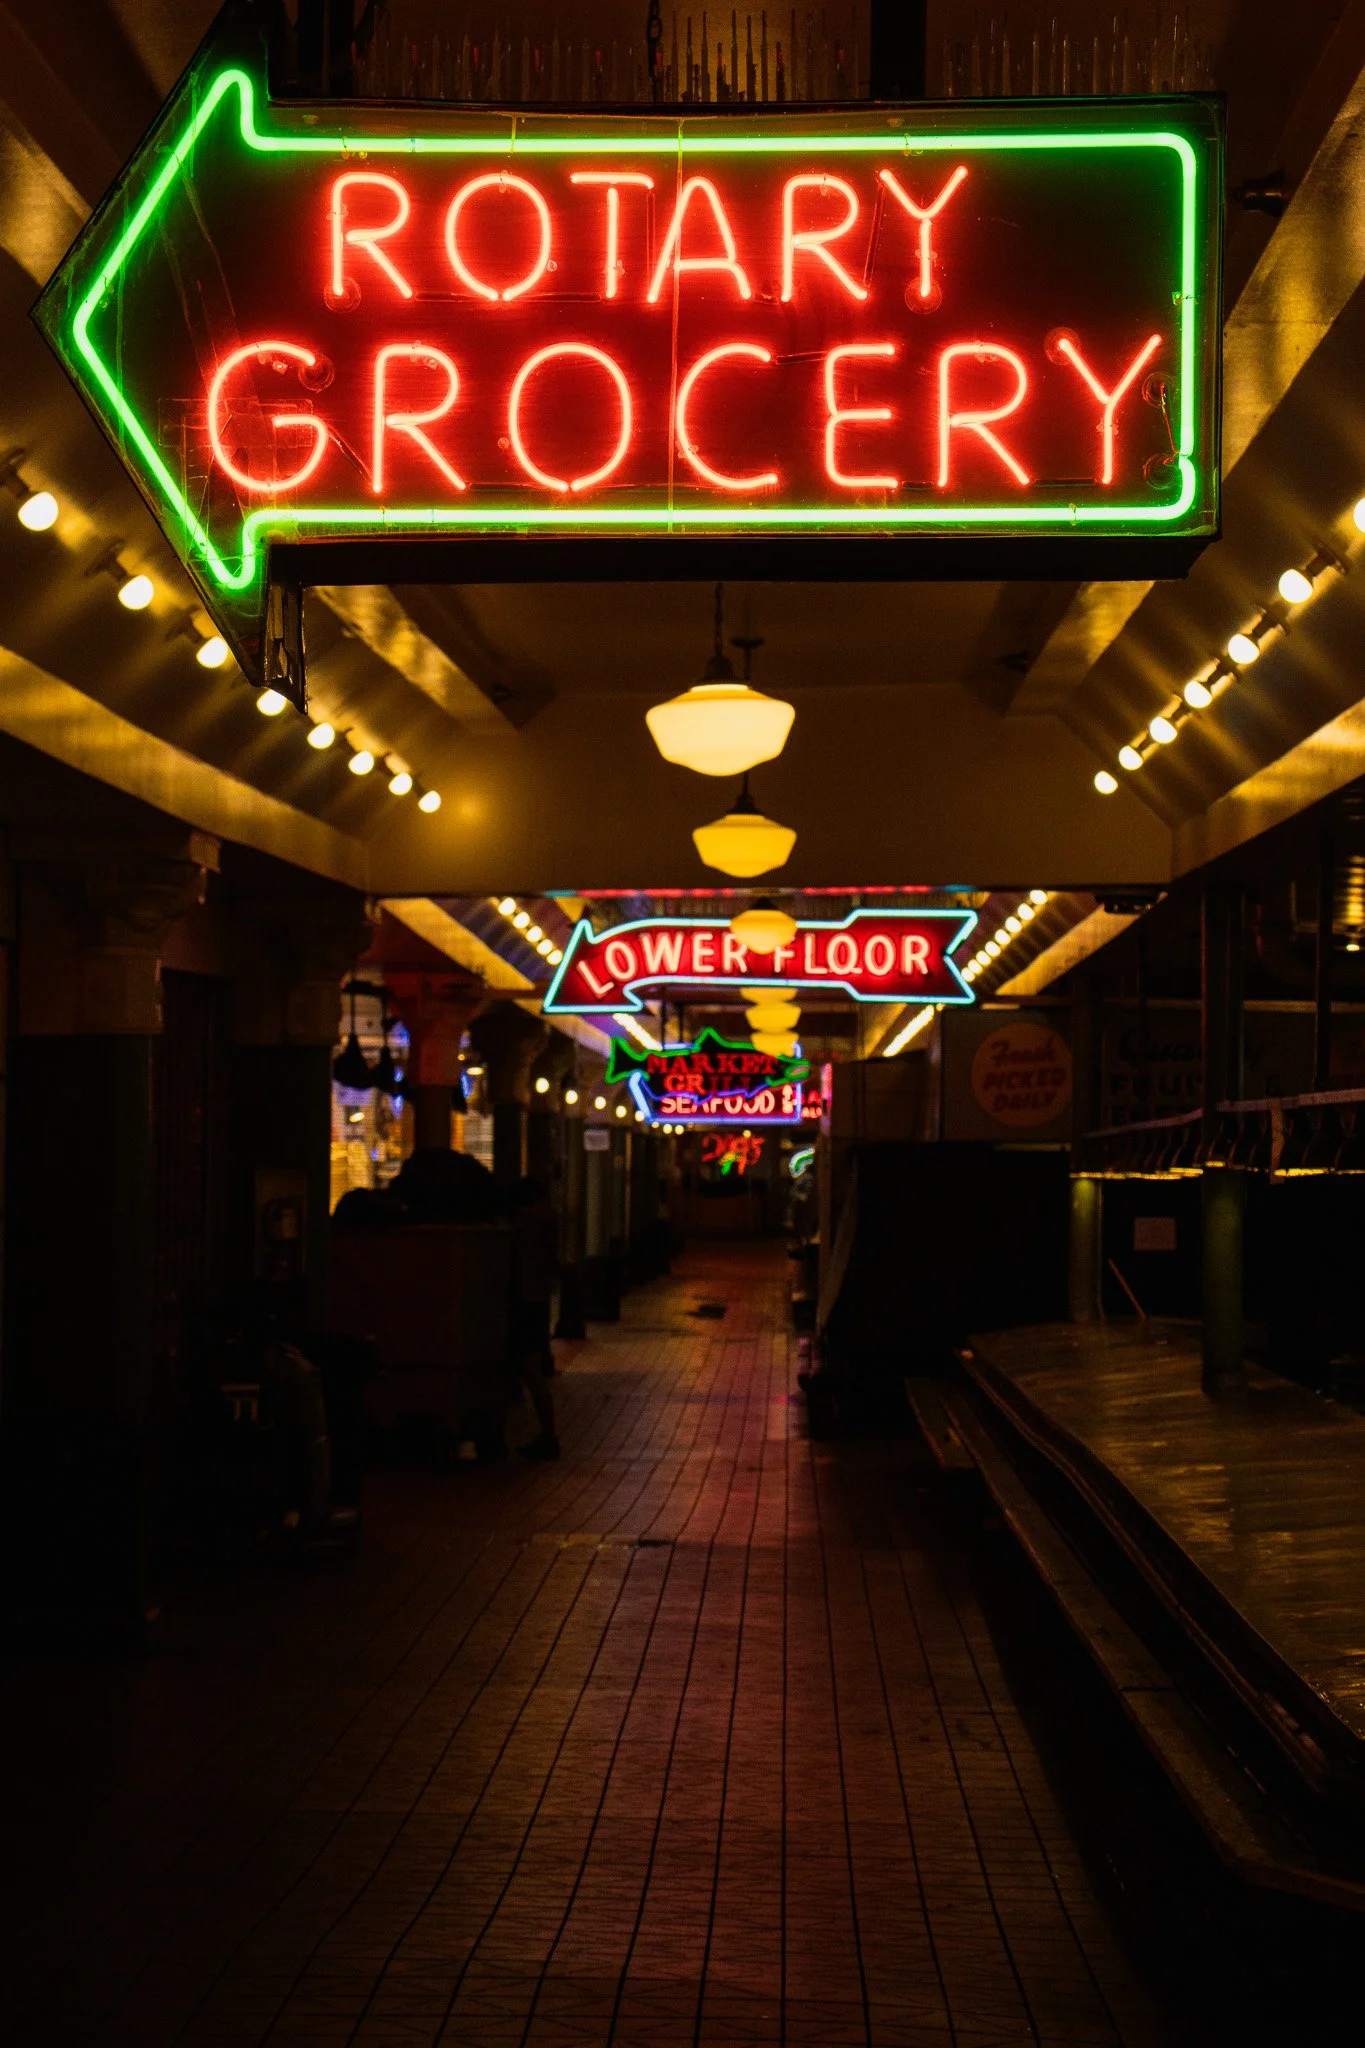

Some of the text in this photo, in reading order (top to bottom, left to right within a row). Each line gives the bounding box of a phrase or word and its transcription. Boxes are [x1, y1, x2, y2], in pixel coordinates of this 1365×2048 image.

[331, 166, 967, 302] ROTARY
[207, 334, 1163, 494] GROCERY
[577, 933, 930, 998] LOWER FLOOR
[647, 1053, 778, 1076] MARKET
[982, 1067, 1066, 1091] PICKED
[661, 1089, 775, 1114] SEAFOOD
[993, 1090, 1058, 1112] DAILY
